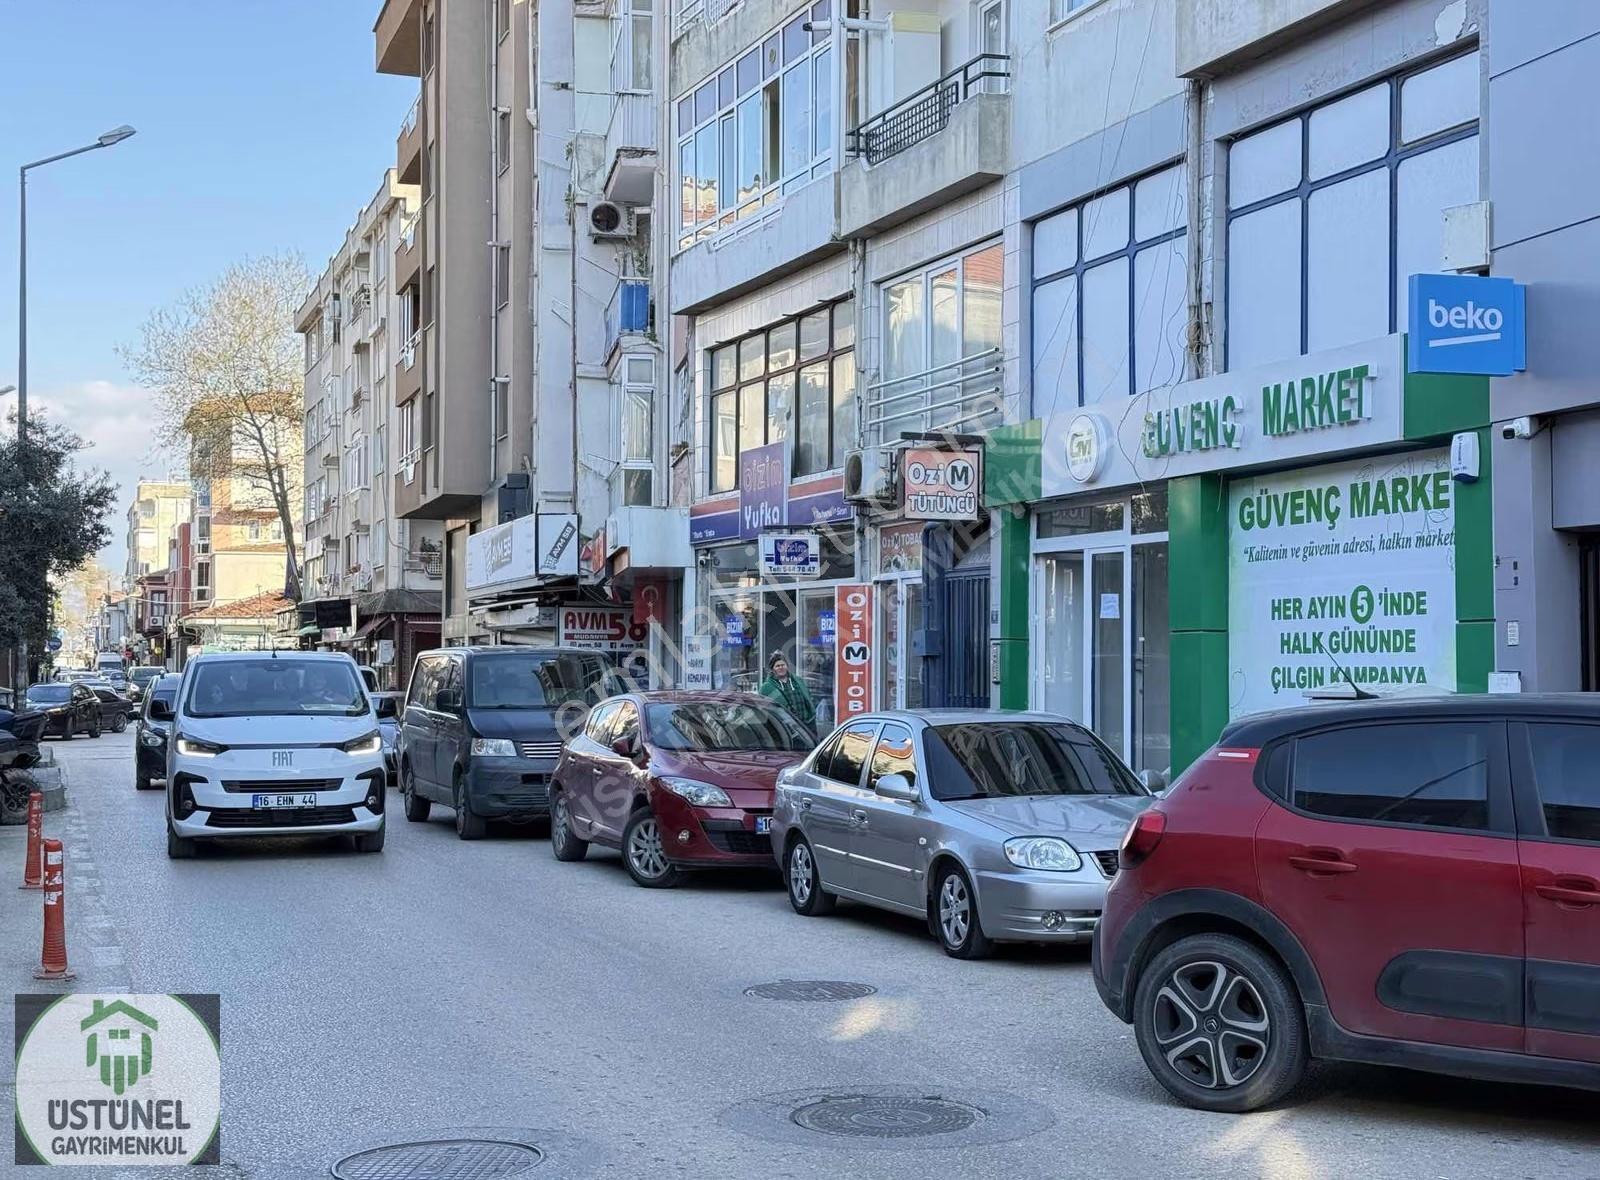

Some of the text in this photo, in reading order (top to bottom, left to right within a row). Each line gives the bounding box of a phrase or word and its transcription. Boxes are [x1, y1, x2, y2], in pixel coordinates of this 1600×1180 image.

[1428, 299, 1503, 330] beko
[1262, 364, 1372, 436] MARKET
[744, 501, 780, 529] Yufka
[908, 492, 975, 514] TÜTÜNCÜ
[1239, 486, 1341, 530] GÜVENÇ
[1290, 549, 1301, 559] ve
[1302, 539, 1340, 562] güvenin
[1343, 537, 1376, 555] adresi,
[1379, 532, 1412, 551] halkın
[1271, 598, 1303, 620] HER
[1307, 595, 1346, 619] AYIN
[1280, 625, 1416, 654] HALK GÜNÜNDE
[1271, 666, 1427, 694] ÇILGIN KAMPANYA
[272, 751, 294, 767] FIAT
[260, 795, 314, 807] 16 EHN 44
